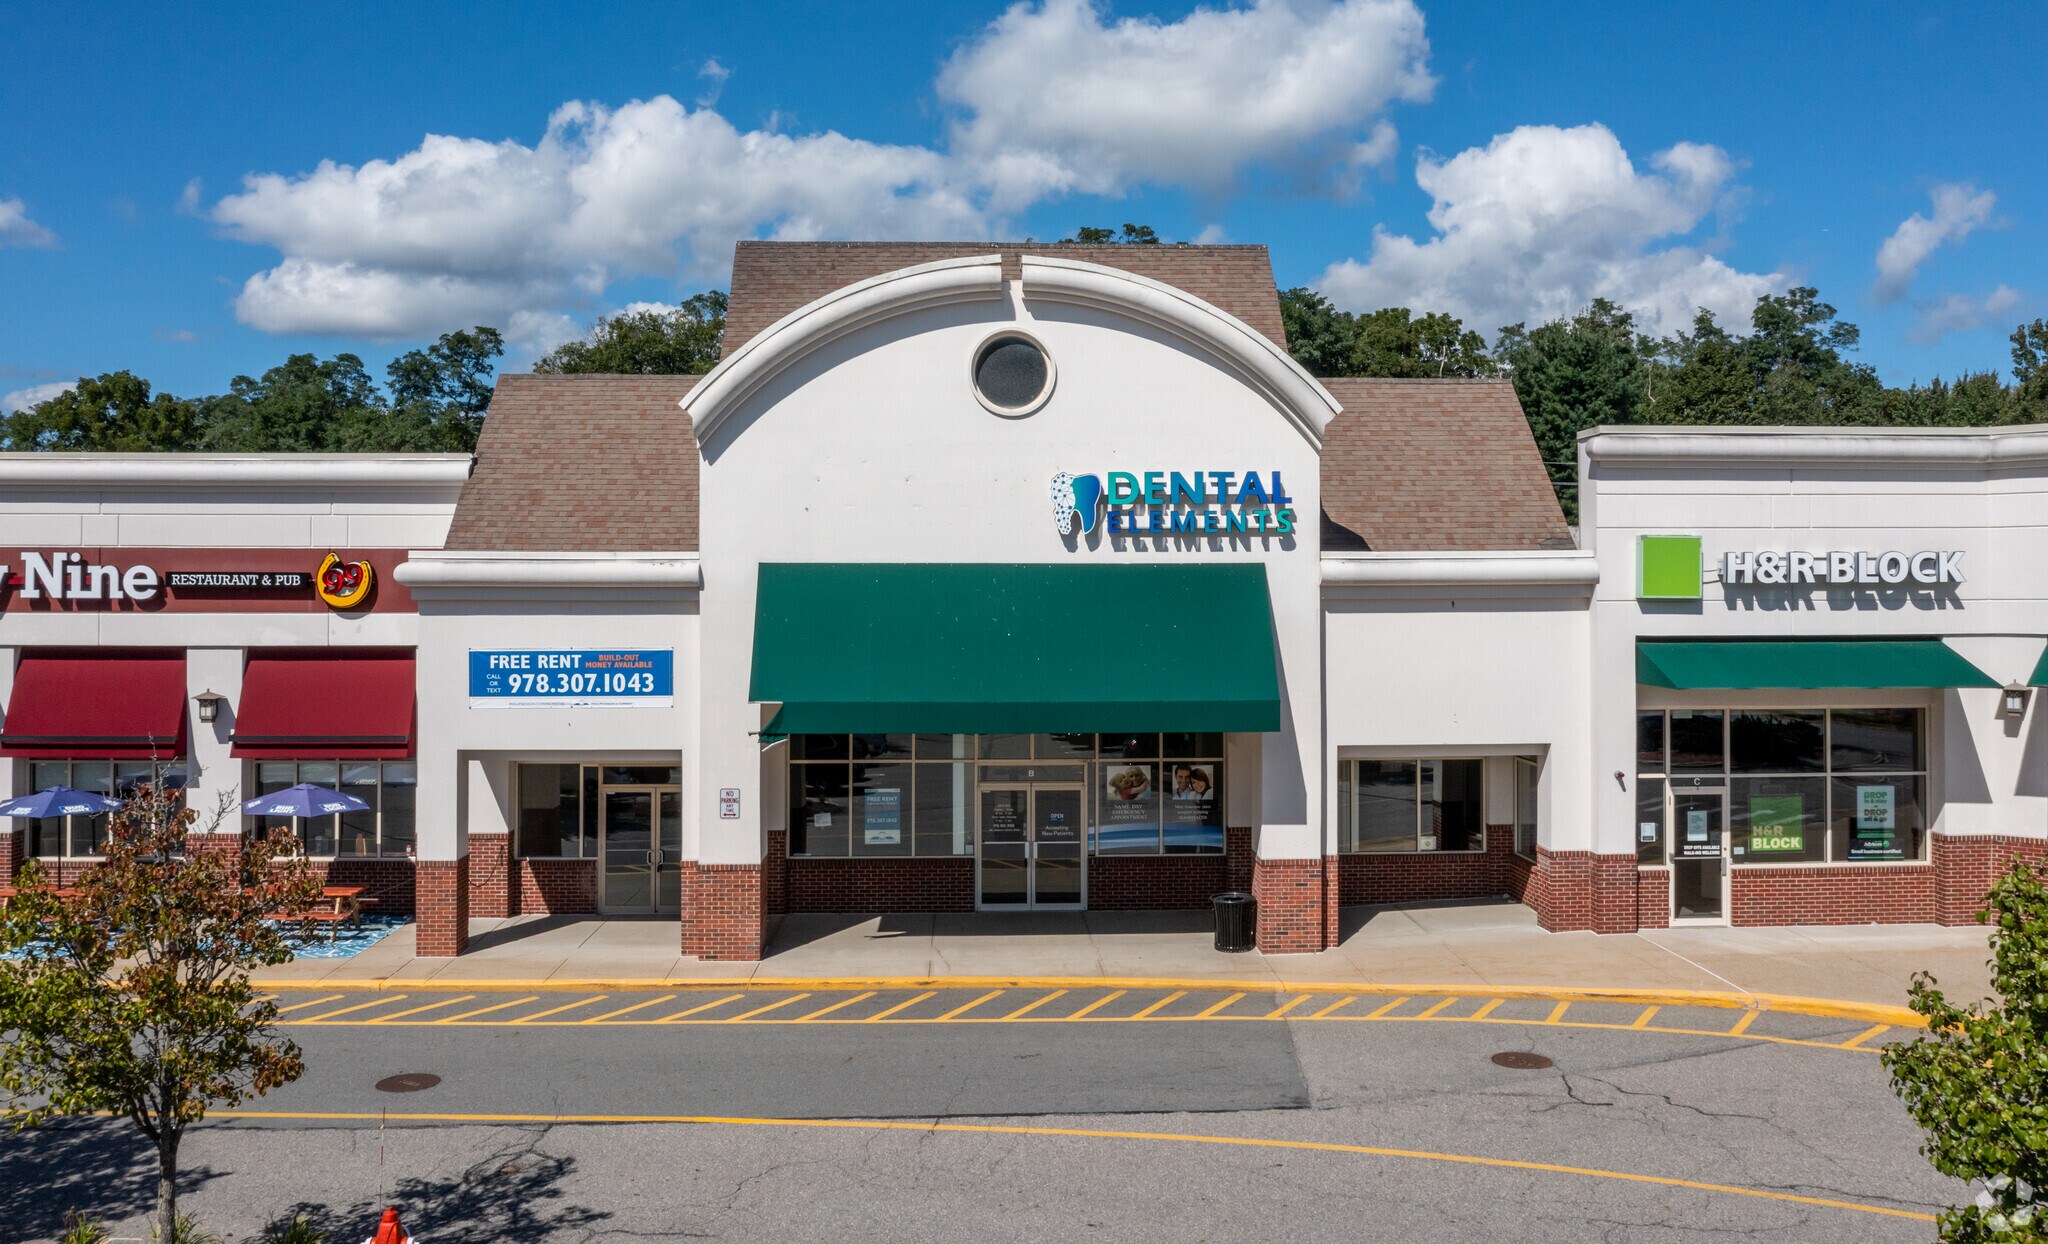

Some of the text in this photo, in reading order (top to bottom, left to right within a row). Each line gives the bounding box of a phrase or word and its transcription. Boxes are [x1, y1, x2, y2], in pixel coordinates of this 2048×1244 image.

[1107, 471, 1293, 505] DENTAL
[1106, 510, 1292, 534] ELEMENTS
[1723, 551, 1967, 584] H&R BLOCK
[20, 552, 158, 600] Nine
[171, 574, 301, 586] RESTAURANT & PUB
[322, 561, 364, 596] 99
[489, 654, 582, 669] FREE RENT
[585, 661, 653, 669] MONEY AVAILABLE
[508, 673, 655, 694] 978.307.1043
[1028, 769, 1035, 777] B
[1693, 778, 1701, 786] C
[1753, 825, 1784, 837] H&R
[1752, 837, 1800, 849] BLOCK
